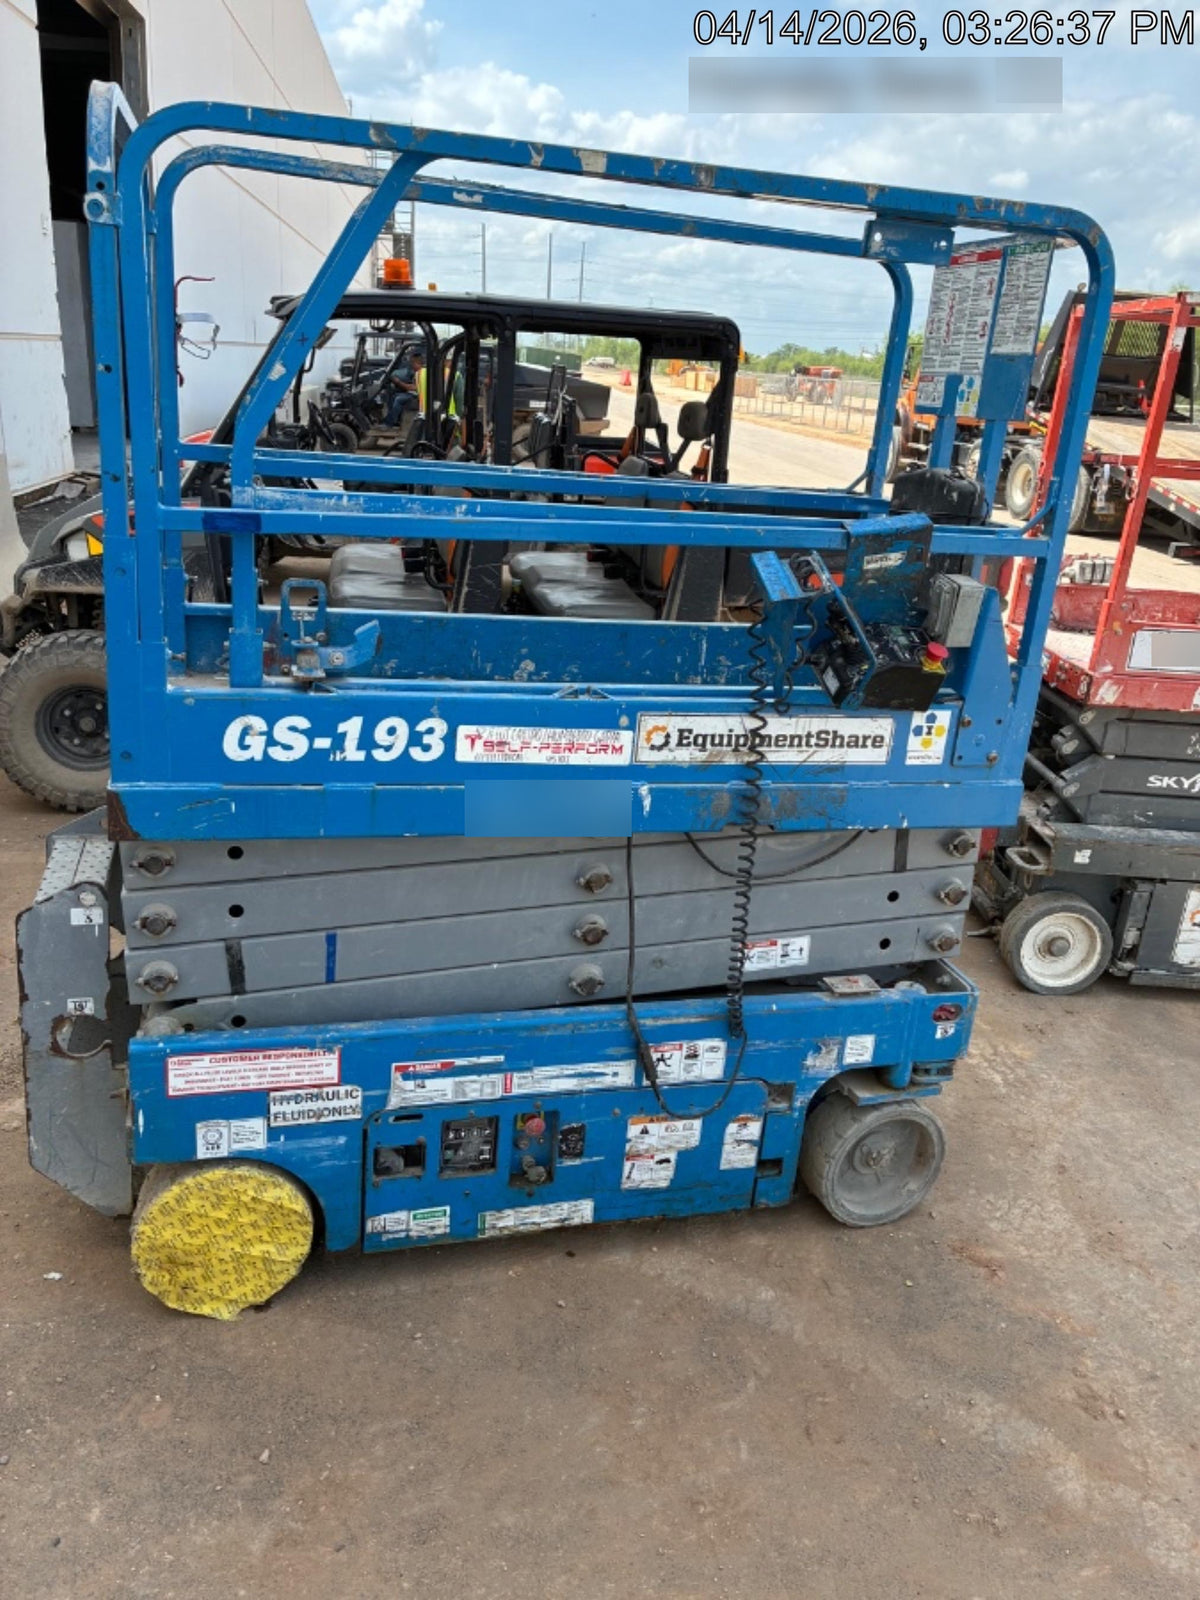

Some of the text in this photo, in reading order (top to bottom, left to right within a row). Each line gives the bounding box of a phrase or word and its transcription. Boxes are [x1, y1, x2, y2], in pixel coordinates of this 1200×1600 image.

[222, 714, 448, 762] GS-193
[483, 739, 624, 755] SELF-PERFORM
[273, 1108, 316, 1122] FLUID
